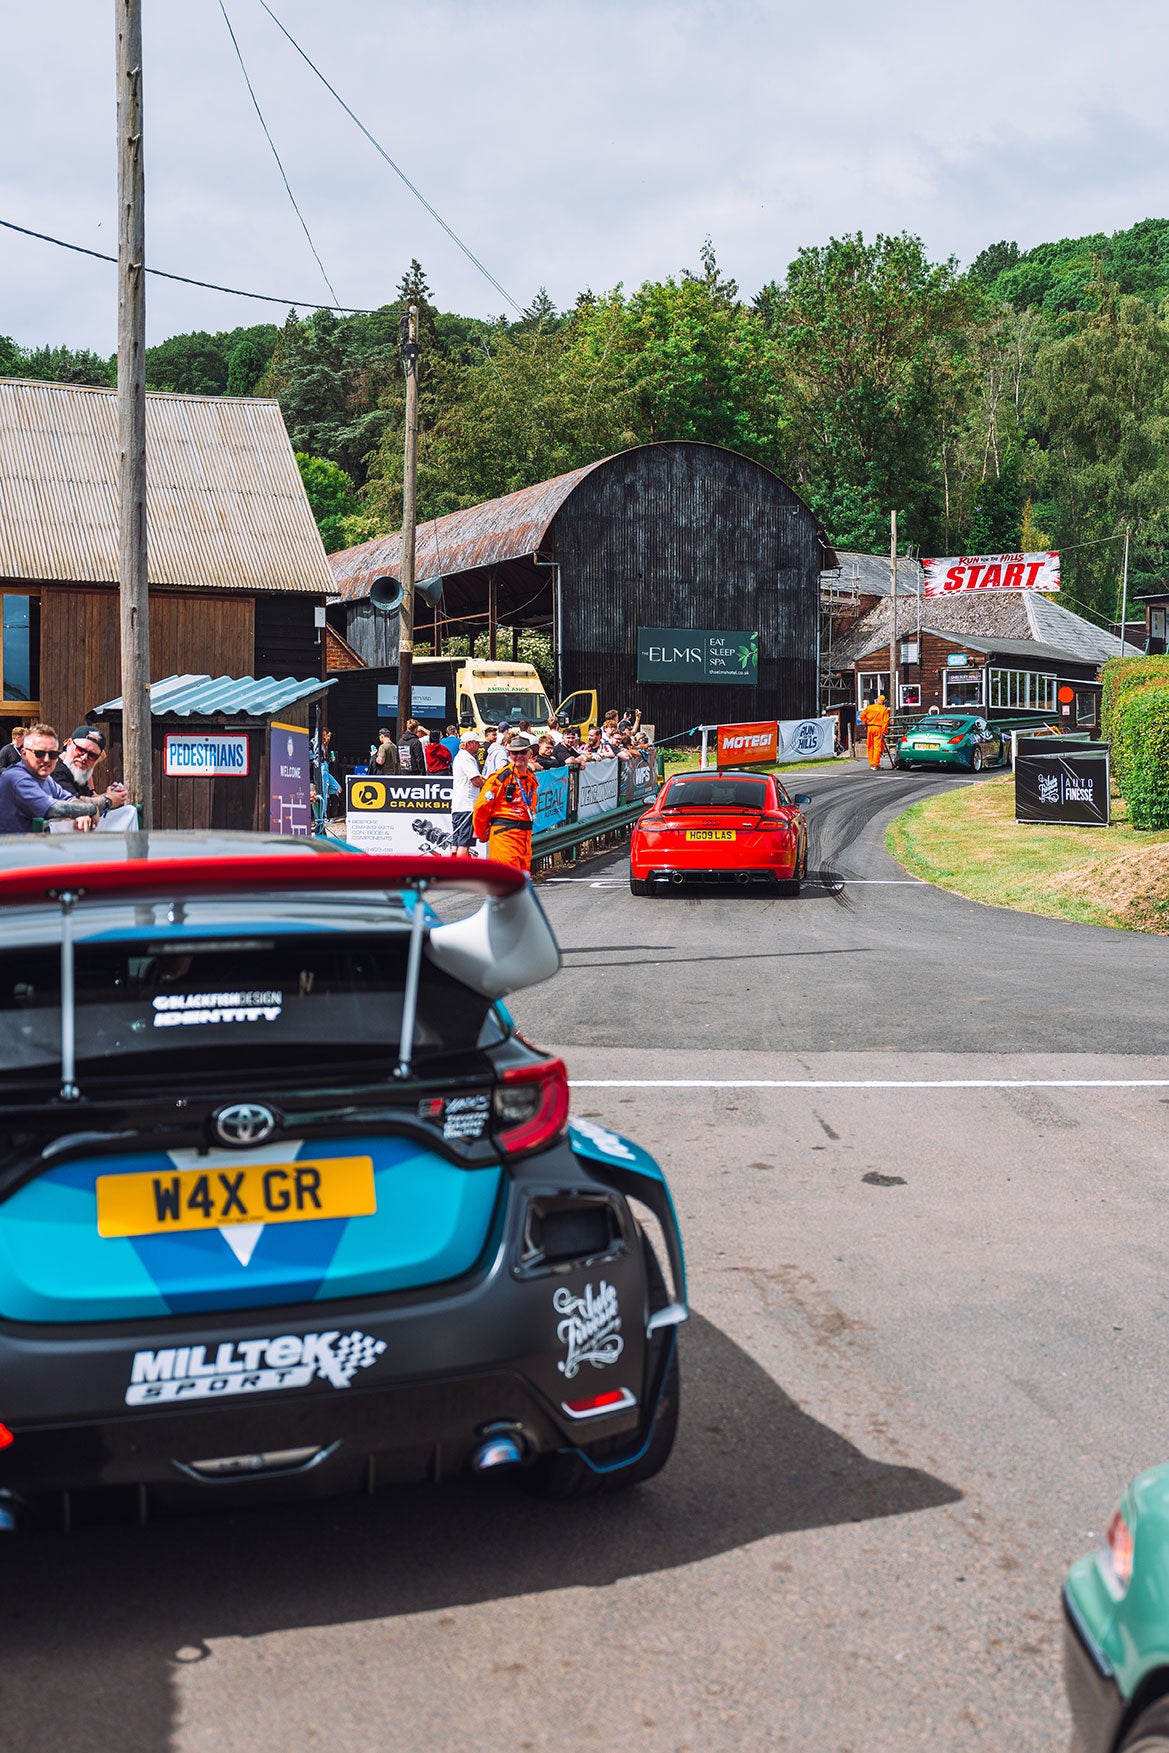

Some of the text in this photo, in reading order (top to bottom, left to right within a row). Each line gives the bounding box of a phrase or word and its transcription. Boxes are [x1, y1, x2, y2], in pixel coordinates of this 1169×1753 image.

[959, 556, 980, 566] RUN
[1000, 554, 1024, 563] HILLS
[943, 562, 1046, 591] START
[709, 638, 725, 646] EAT
[649, 647, 702, 662] ELMS
[709, 648, 735, 656] SLEEP
[709, 658, 726, 666] SPA
[722, 733, 773, 750] MOTEGI
[169, 743, 244, 767] PEDESTRIANS
[280, 765, 301, 779] WELCOME
[1065, 778, 1094, 788] AUTO
[1065, 787, 1094, 801] FINESSE
[390, 801, 452, 809] CRANKSH
[690, 831, 733, 840] HG09 LAS
[152, 1167, 322, 1222] W4X GR
[143, 1369, 293, 1398] SPORT
